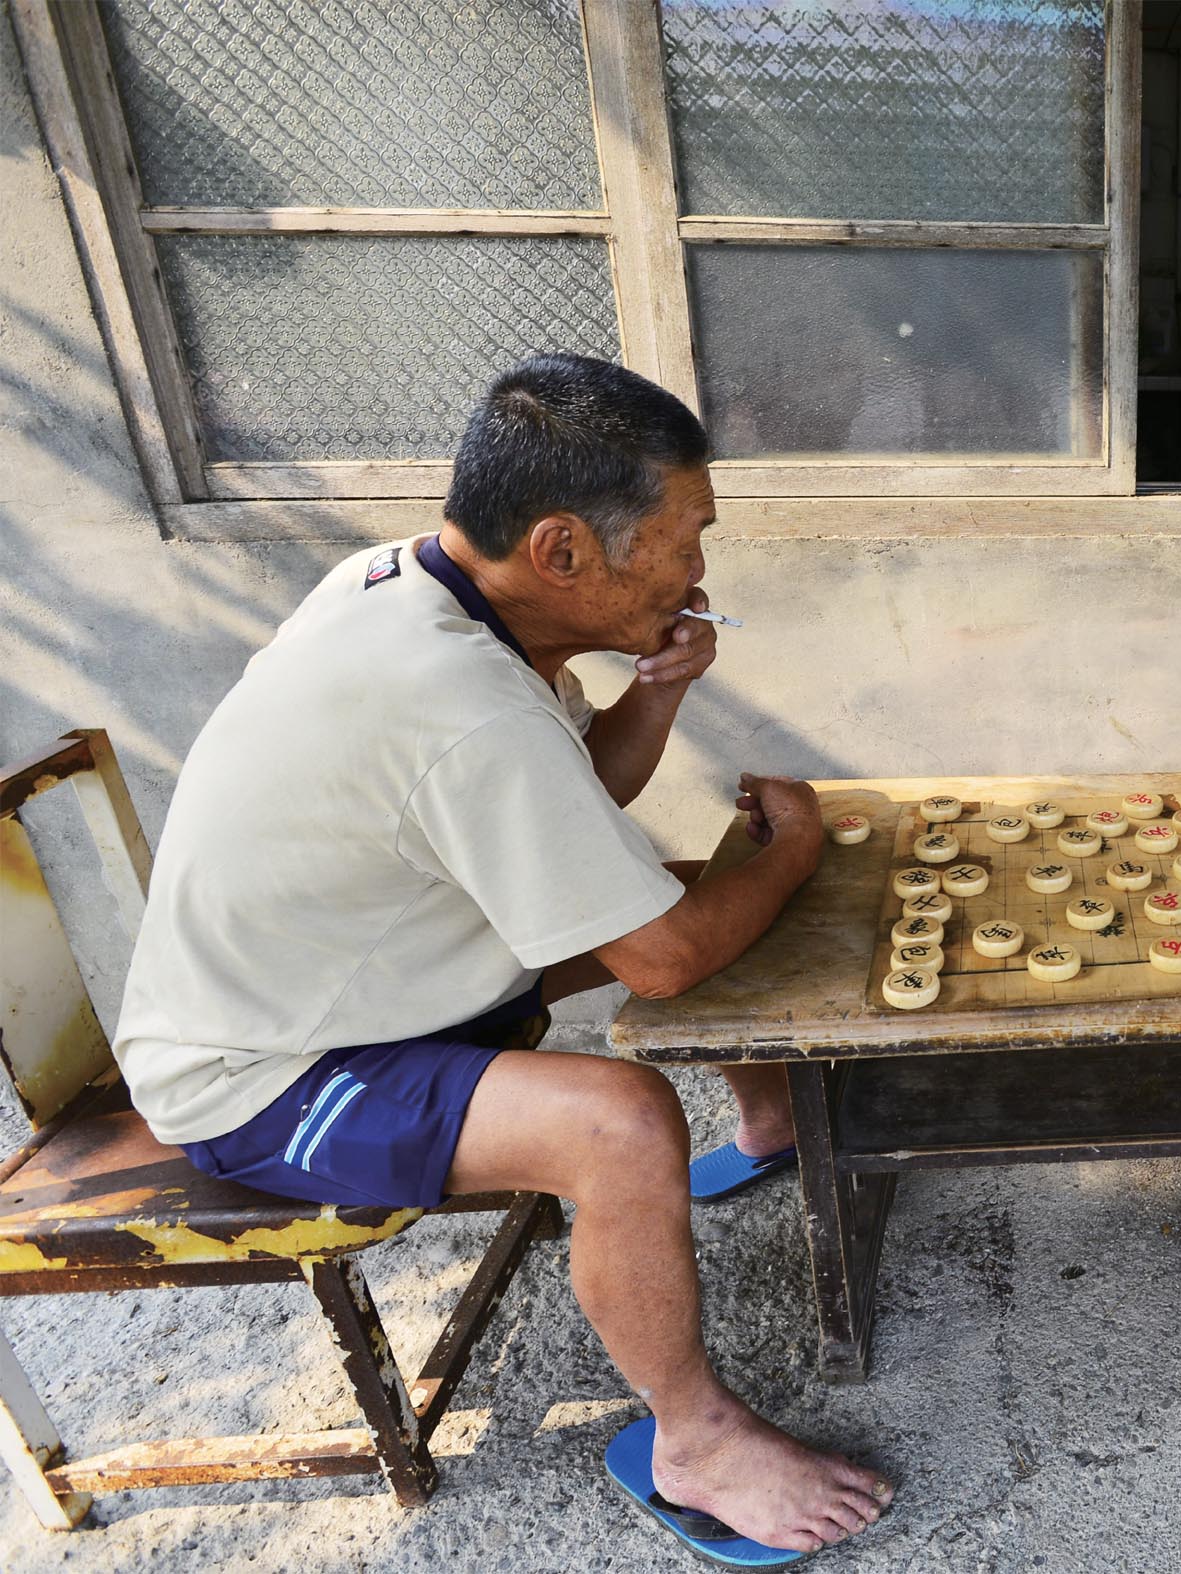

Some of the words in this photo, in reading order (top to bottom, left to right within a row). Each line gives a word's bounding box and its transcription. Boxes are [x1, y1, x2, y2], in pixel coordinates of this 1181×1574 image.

[1128, 793, 1153, 805] 兵
[834, 817, 863, 828] 兵
[994, 818, 1022, 828] 包
[1142, 826, 1169, 837] 兵
[950, 866, 977, 881] 士
[911, 895, 940, 911] 士
[1153, 892, 1179, 909] 兵
[981, 923, 1014, 939] 馬
[901, 945, 931, 962] 包
[1035, 946, 1070, 961] 卒
